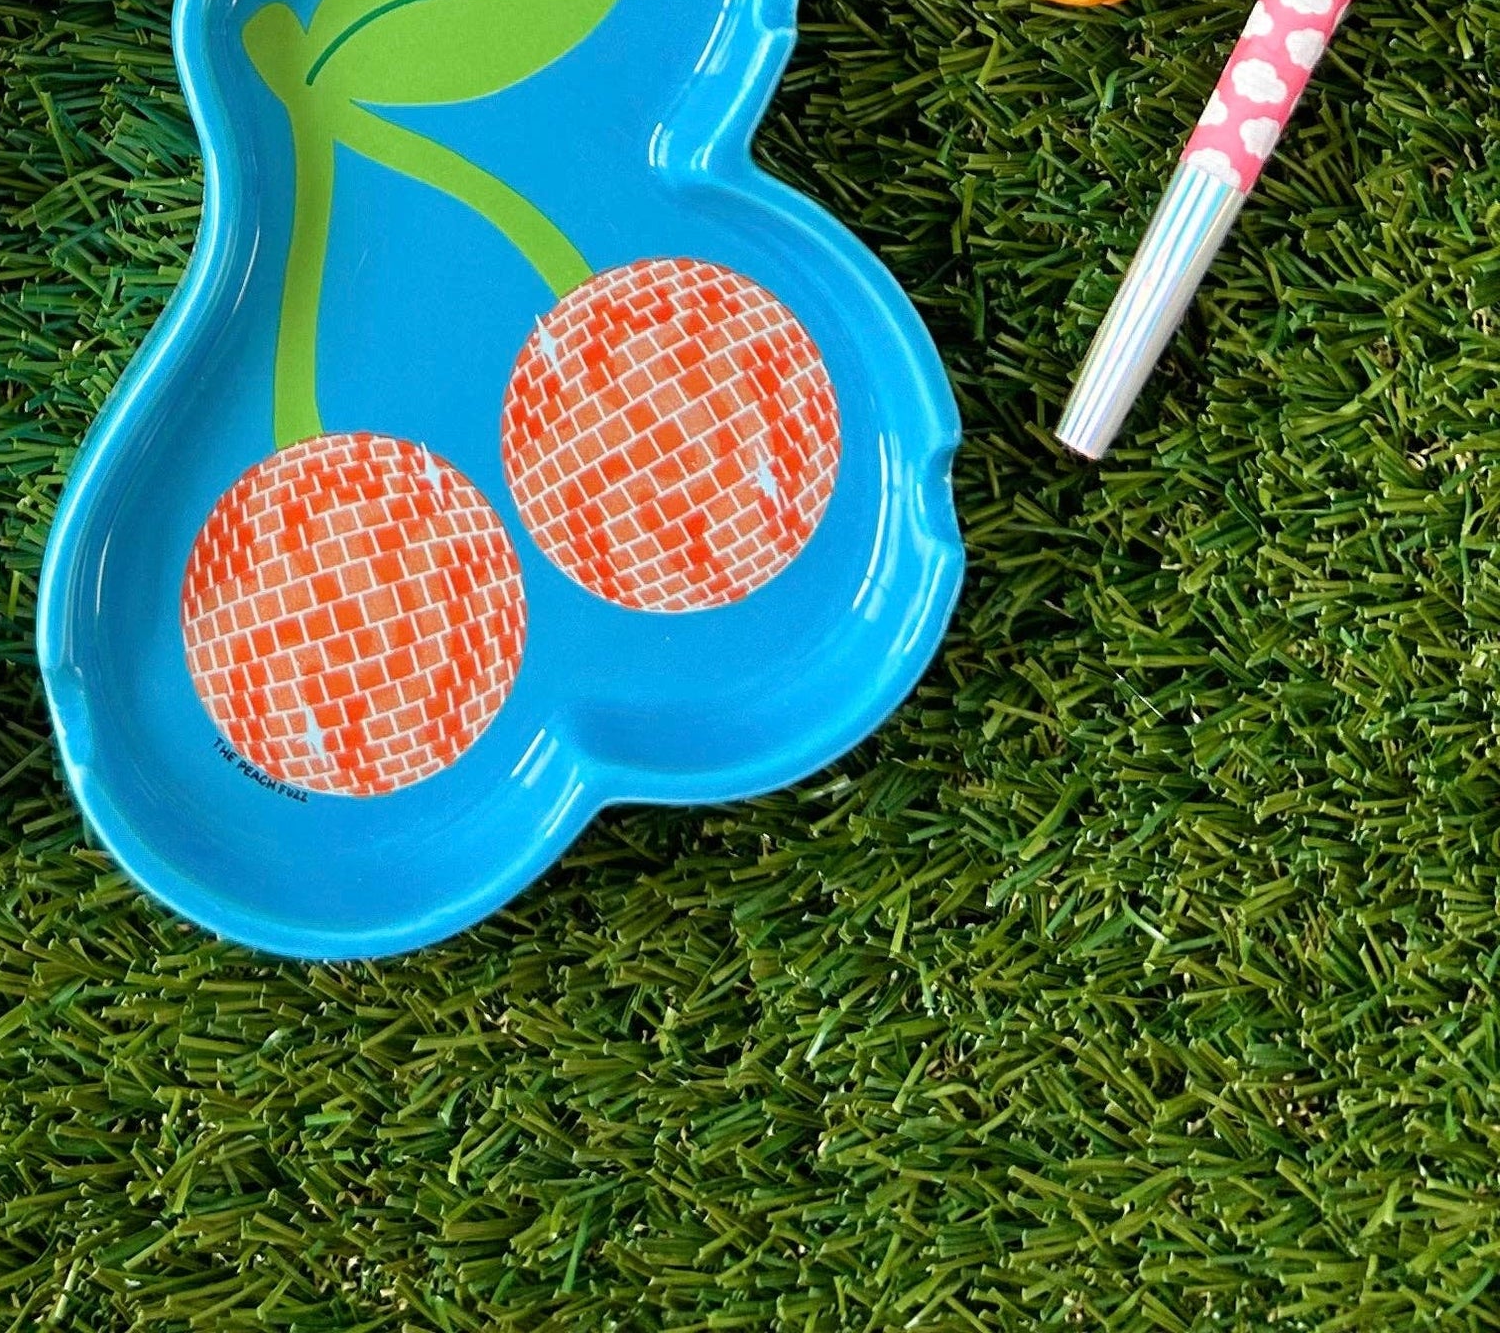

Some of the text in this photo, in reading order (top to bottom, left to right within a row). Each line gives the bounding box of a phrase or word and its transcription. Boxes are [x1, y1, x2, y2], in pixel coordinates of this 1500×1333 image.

[213, 737, 308, 803] THE PEACH FUZZ
